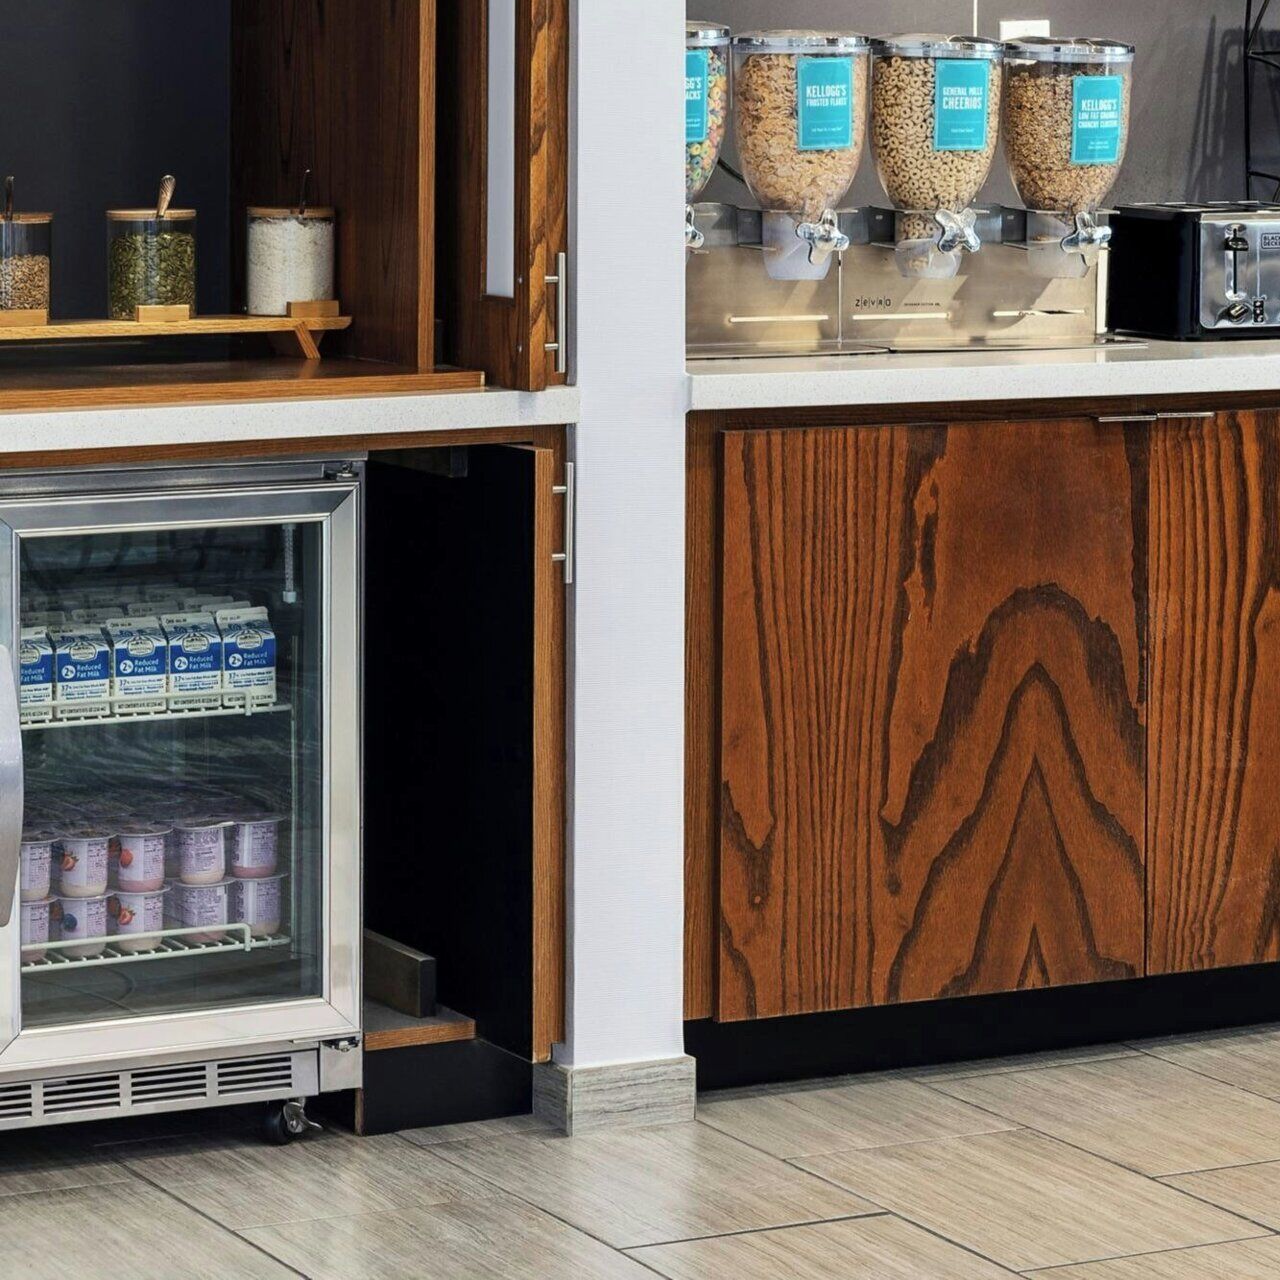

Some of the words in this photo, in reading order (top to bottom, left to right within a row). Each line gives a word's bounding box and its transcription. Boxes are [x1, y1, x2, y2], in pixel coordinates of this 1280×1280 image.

[806, 85, 847, 97] KELLOGG'S
[942, 96, 982, 110] CHEERIOS
[1081, 99, 1117, 111] KELLOGG'S
[189, 655, 213, 663] Reduced
